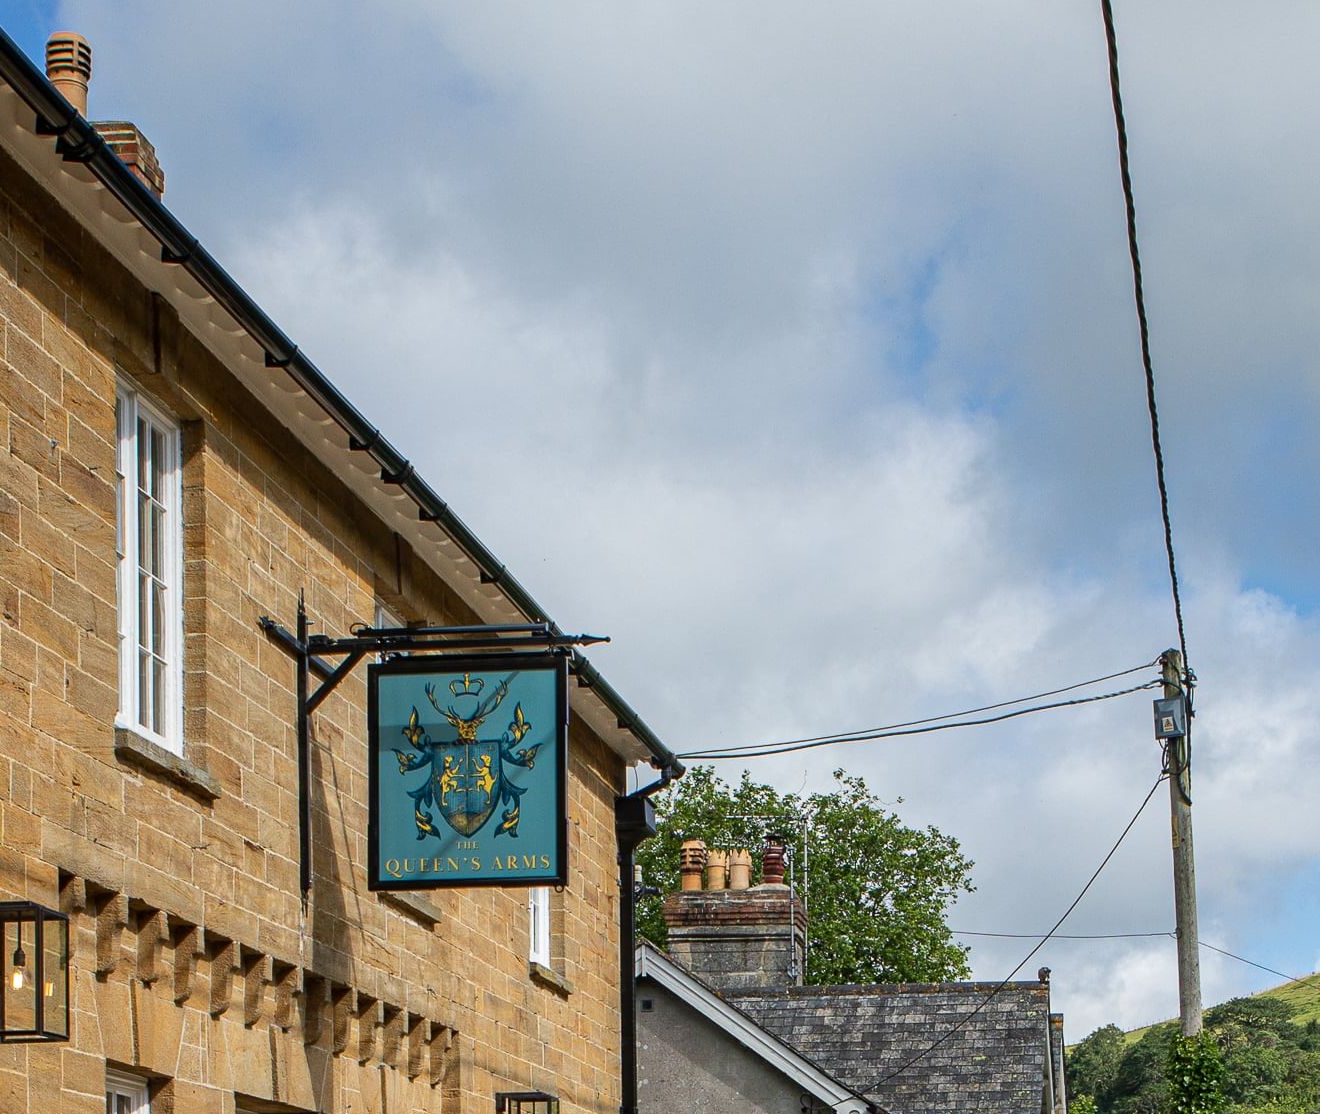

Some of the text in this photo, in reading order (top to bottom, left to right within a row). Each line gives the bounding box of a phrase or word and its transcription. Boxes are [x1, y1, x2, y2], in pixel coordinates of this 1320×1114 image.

[456, 840, 479, 850] THE
[385, 854, 551, 879] QUEEN'S ARMS
